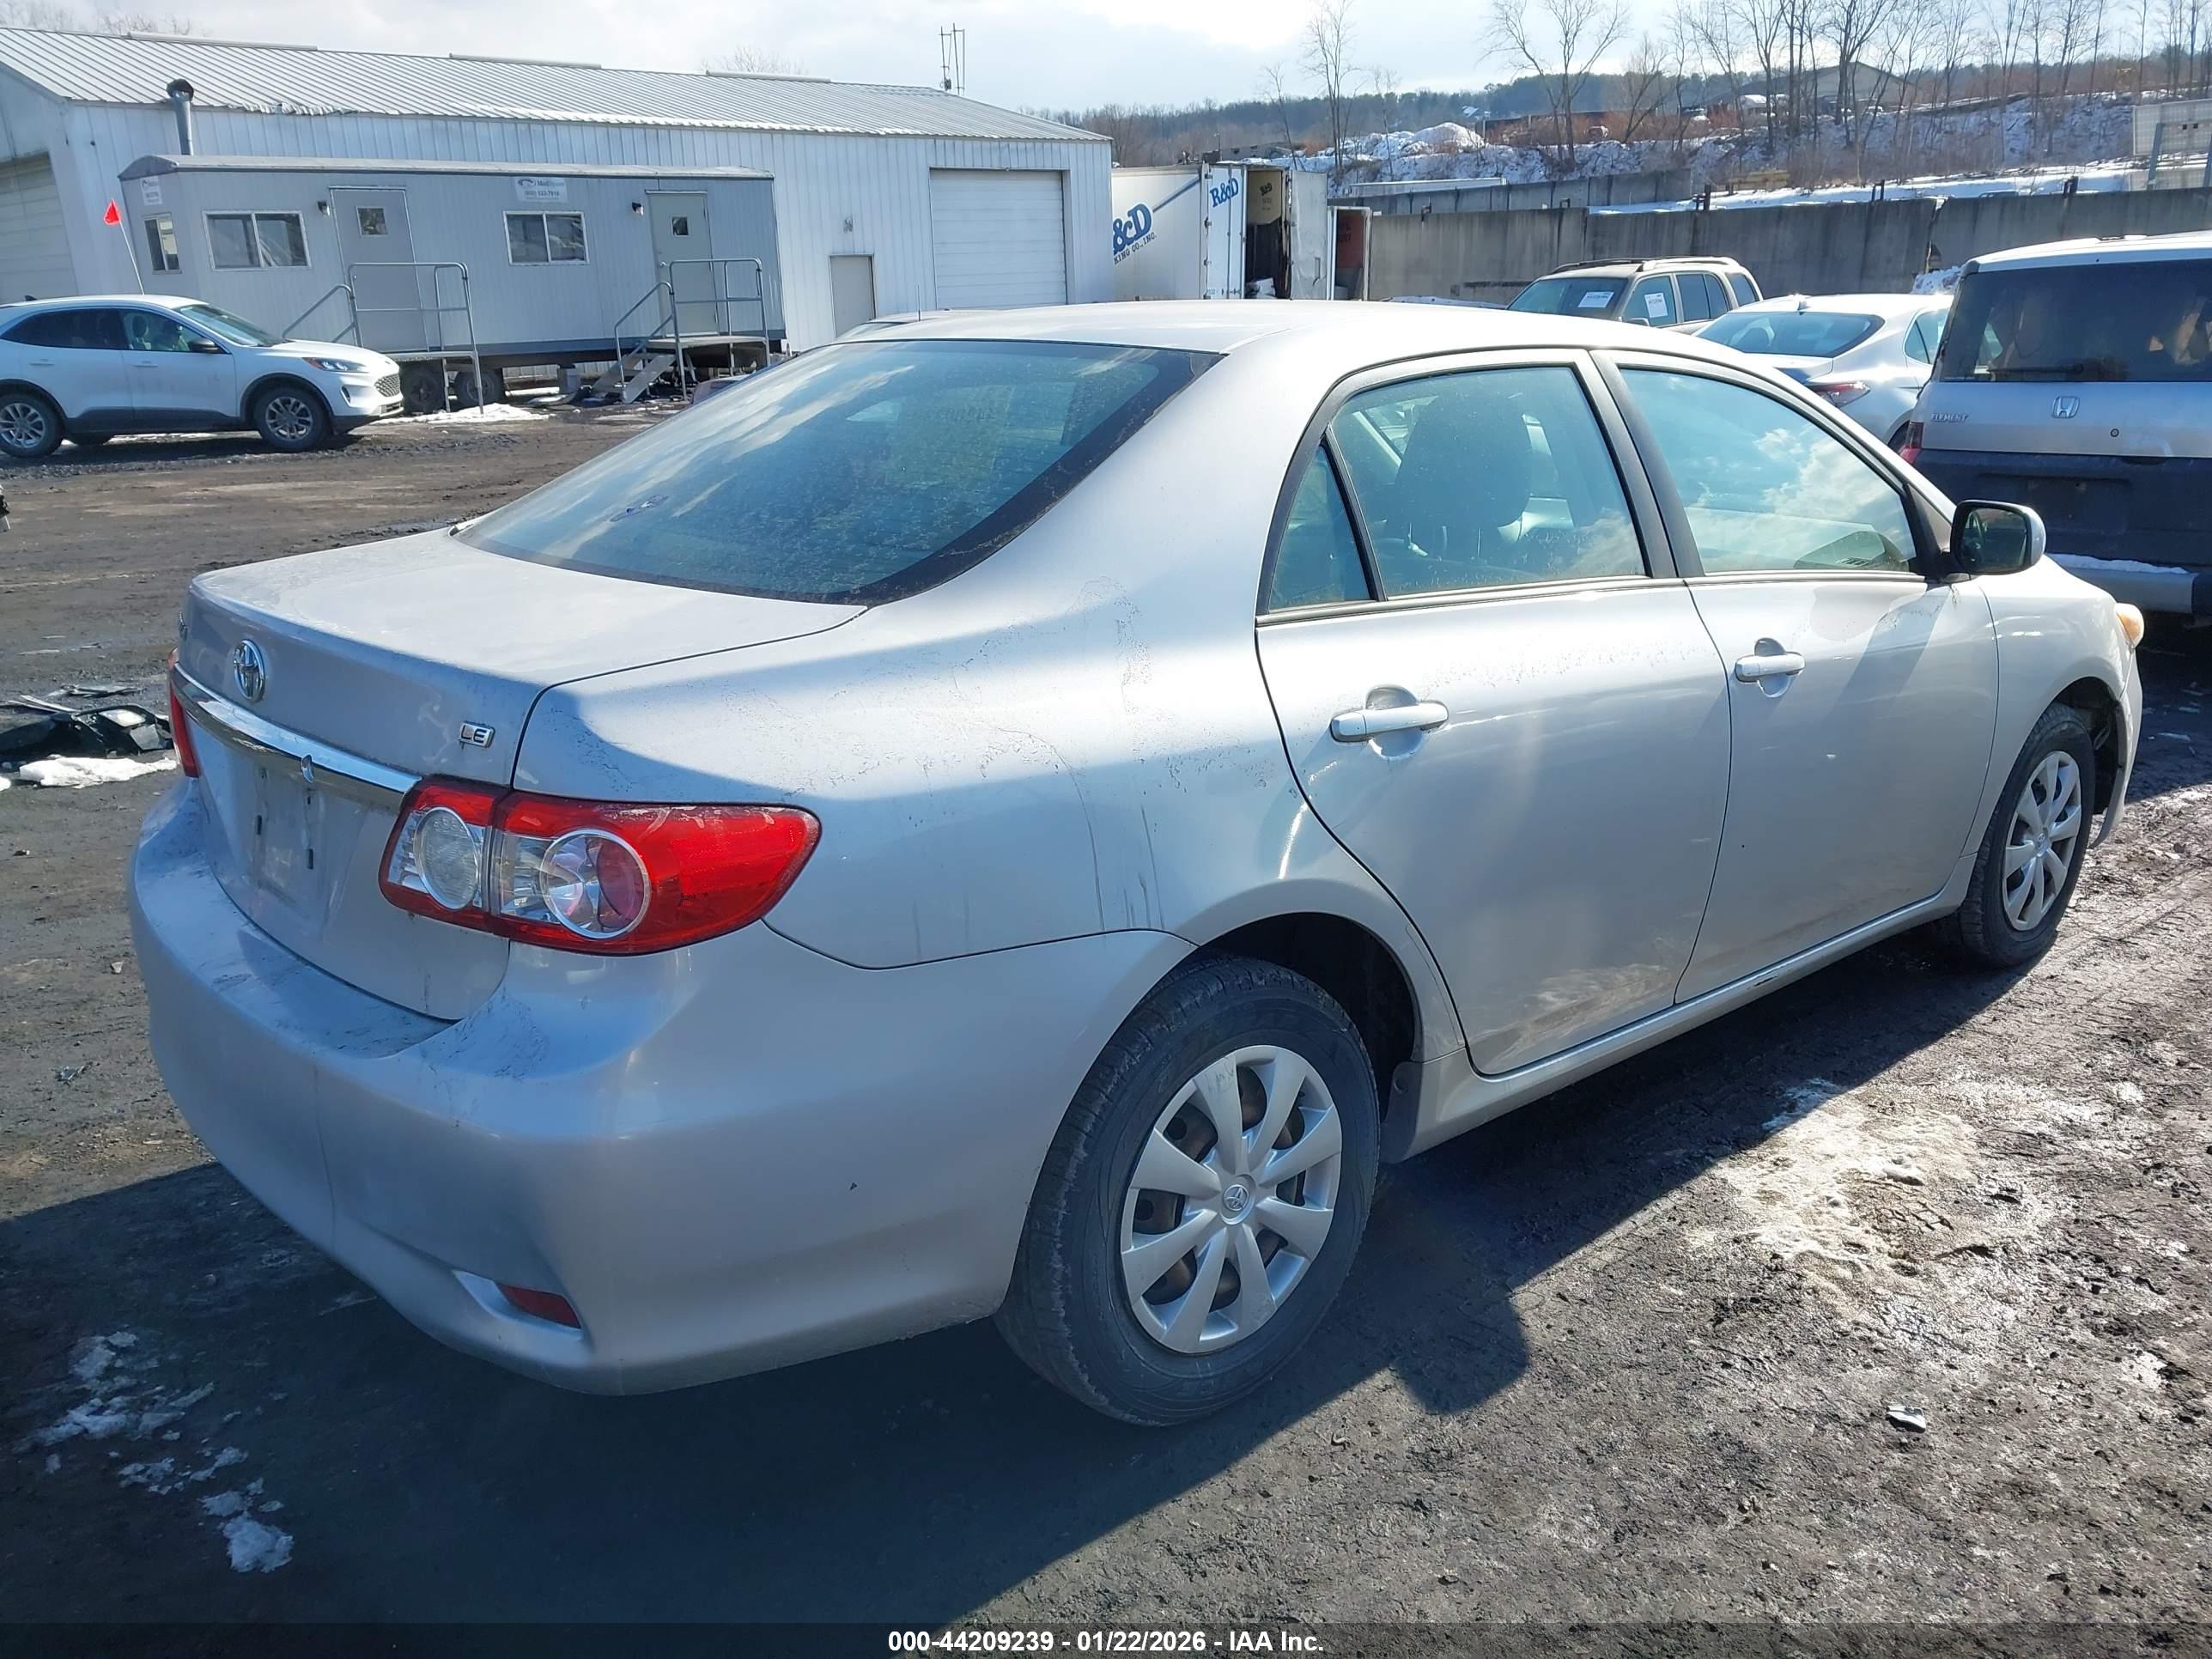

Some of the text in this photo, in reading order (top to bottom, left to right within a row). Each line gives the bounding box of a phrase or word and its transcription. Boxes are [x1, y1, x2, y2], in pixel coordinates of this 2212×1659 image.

[1210, 178, 1238, 208] R&D
[1113, 204, 1152, 256] &D
[1930, 412, 1970, 422] ELEMENT
[460, 725, 489, 744] LE
